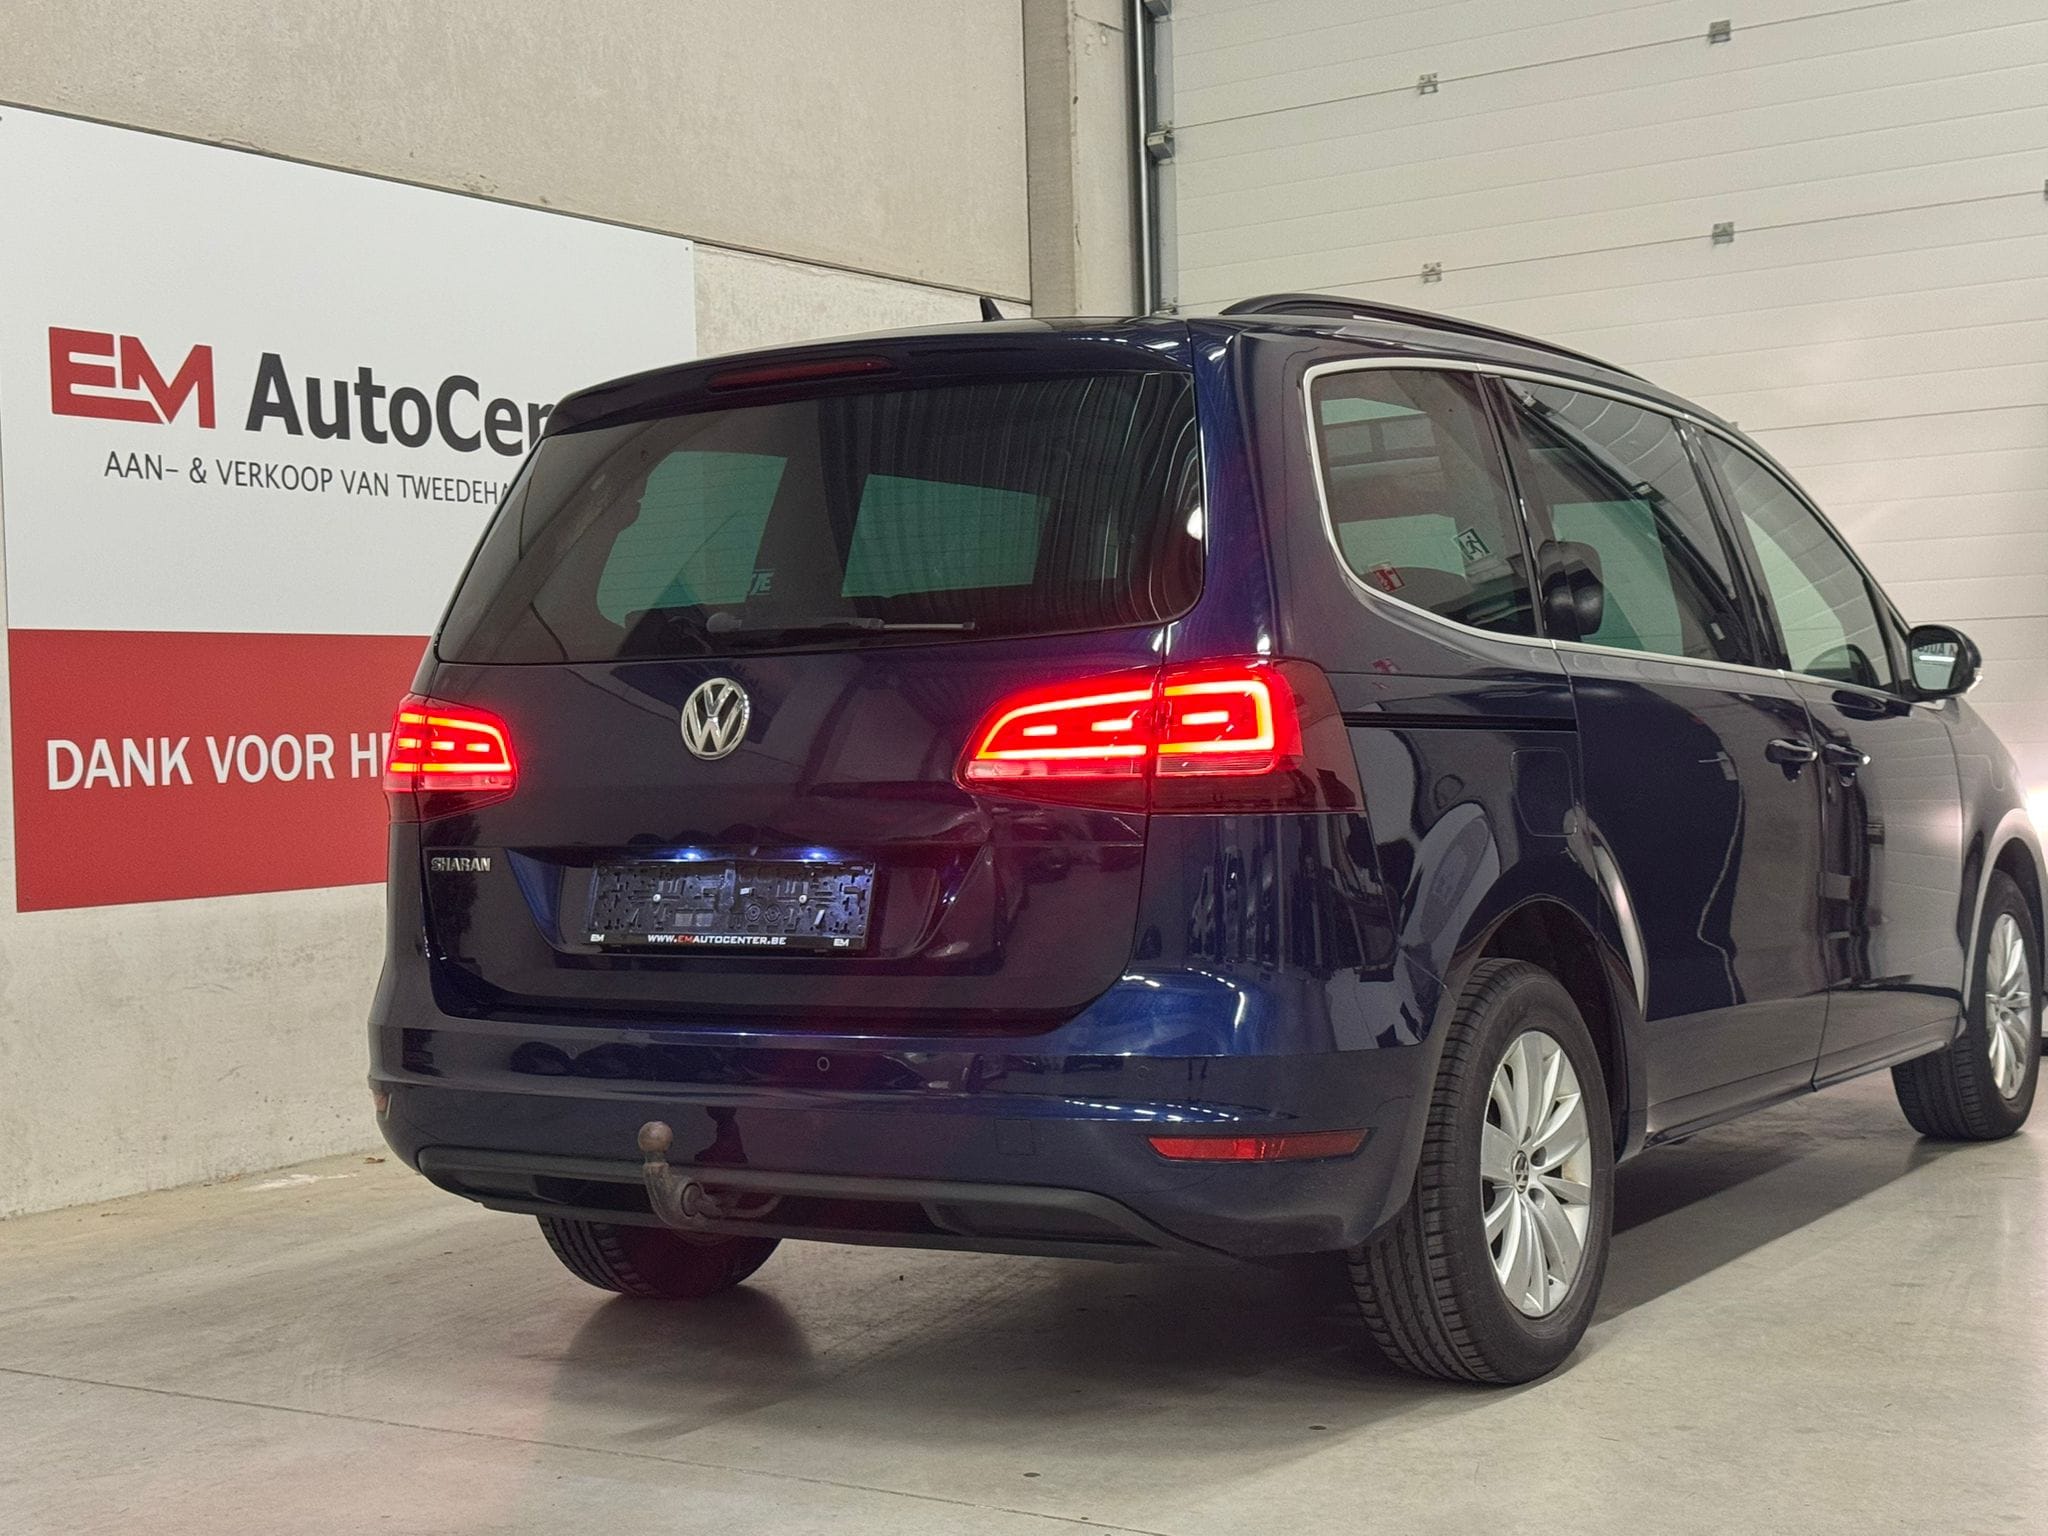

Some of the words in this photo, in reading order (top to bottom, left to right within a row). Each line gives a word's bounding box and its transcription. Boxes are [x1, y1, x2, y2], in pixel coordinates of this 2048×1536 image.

[49, 326, 216, 430] EM
[189, 457, 207, 484] &
[216, 459, 334, 493] VERKOOP
[340, 469, 389, 497] VAN
[681, 677, 750, 761] VW
[47, 736, 193, 790] DANK
[205, 733, 335, 784] VOOR
[431, 857, 491, 872] SHARAN
[647, 934, 787, 946] WWW.EMAUTOCENTER.BE
